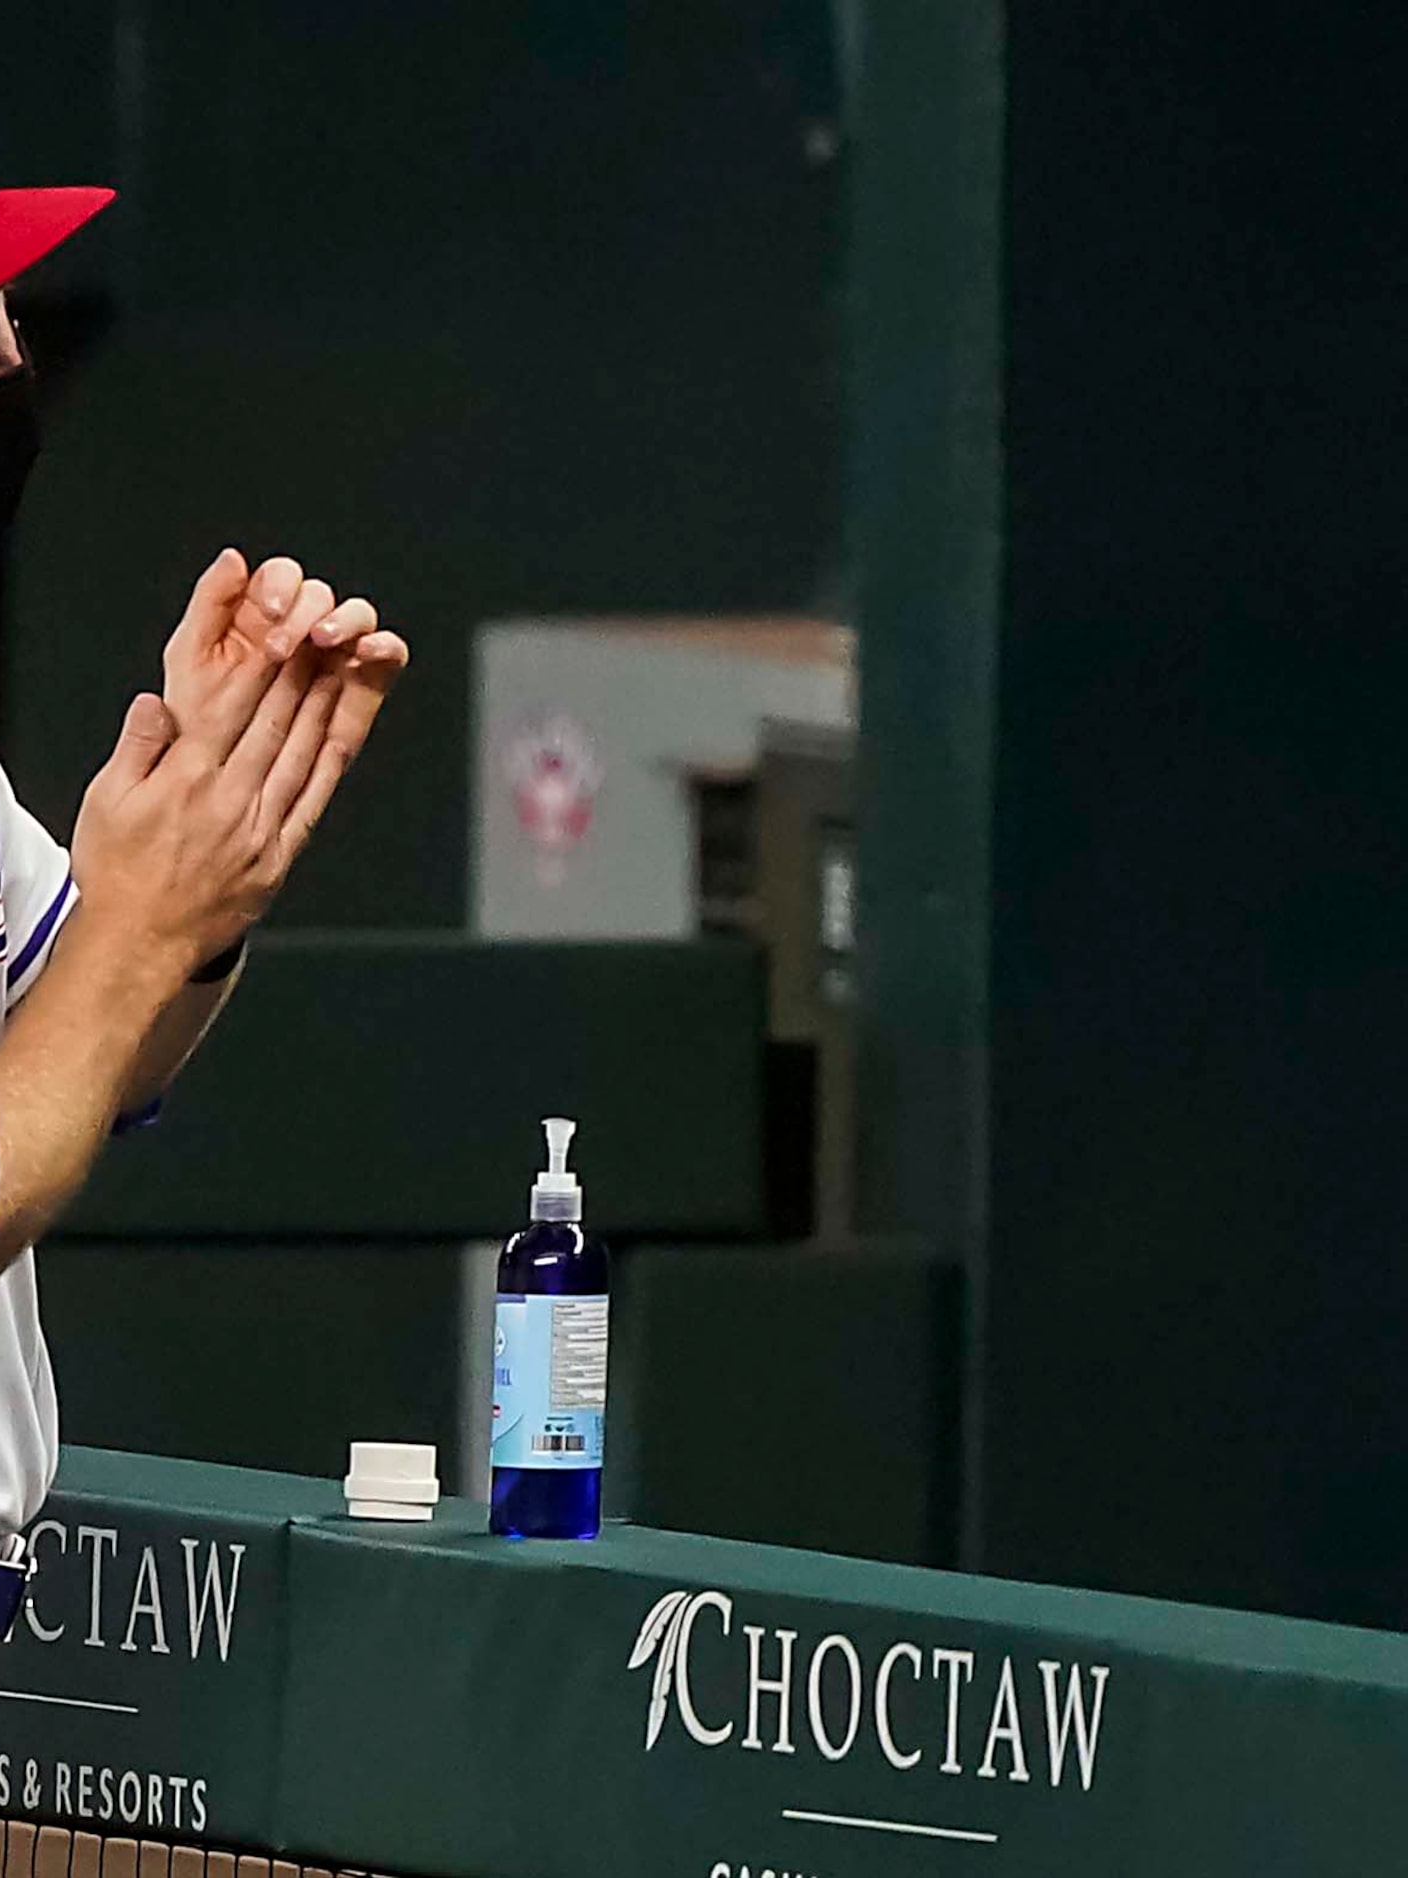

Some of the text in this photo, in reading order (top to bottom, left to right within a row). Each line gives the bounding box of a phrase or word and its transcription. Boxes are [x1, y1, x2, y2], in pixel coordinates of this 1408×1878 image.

[24, 1519, 247, 1662] CTAW
[675, 1590, 1111, 1791] CHOCTAW
[23, 1758, 42, 1811] &
[55, 1761, 209, 1832] RESORTS
